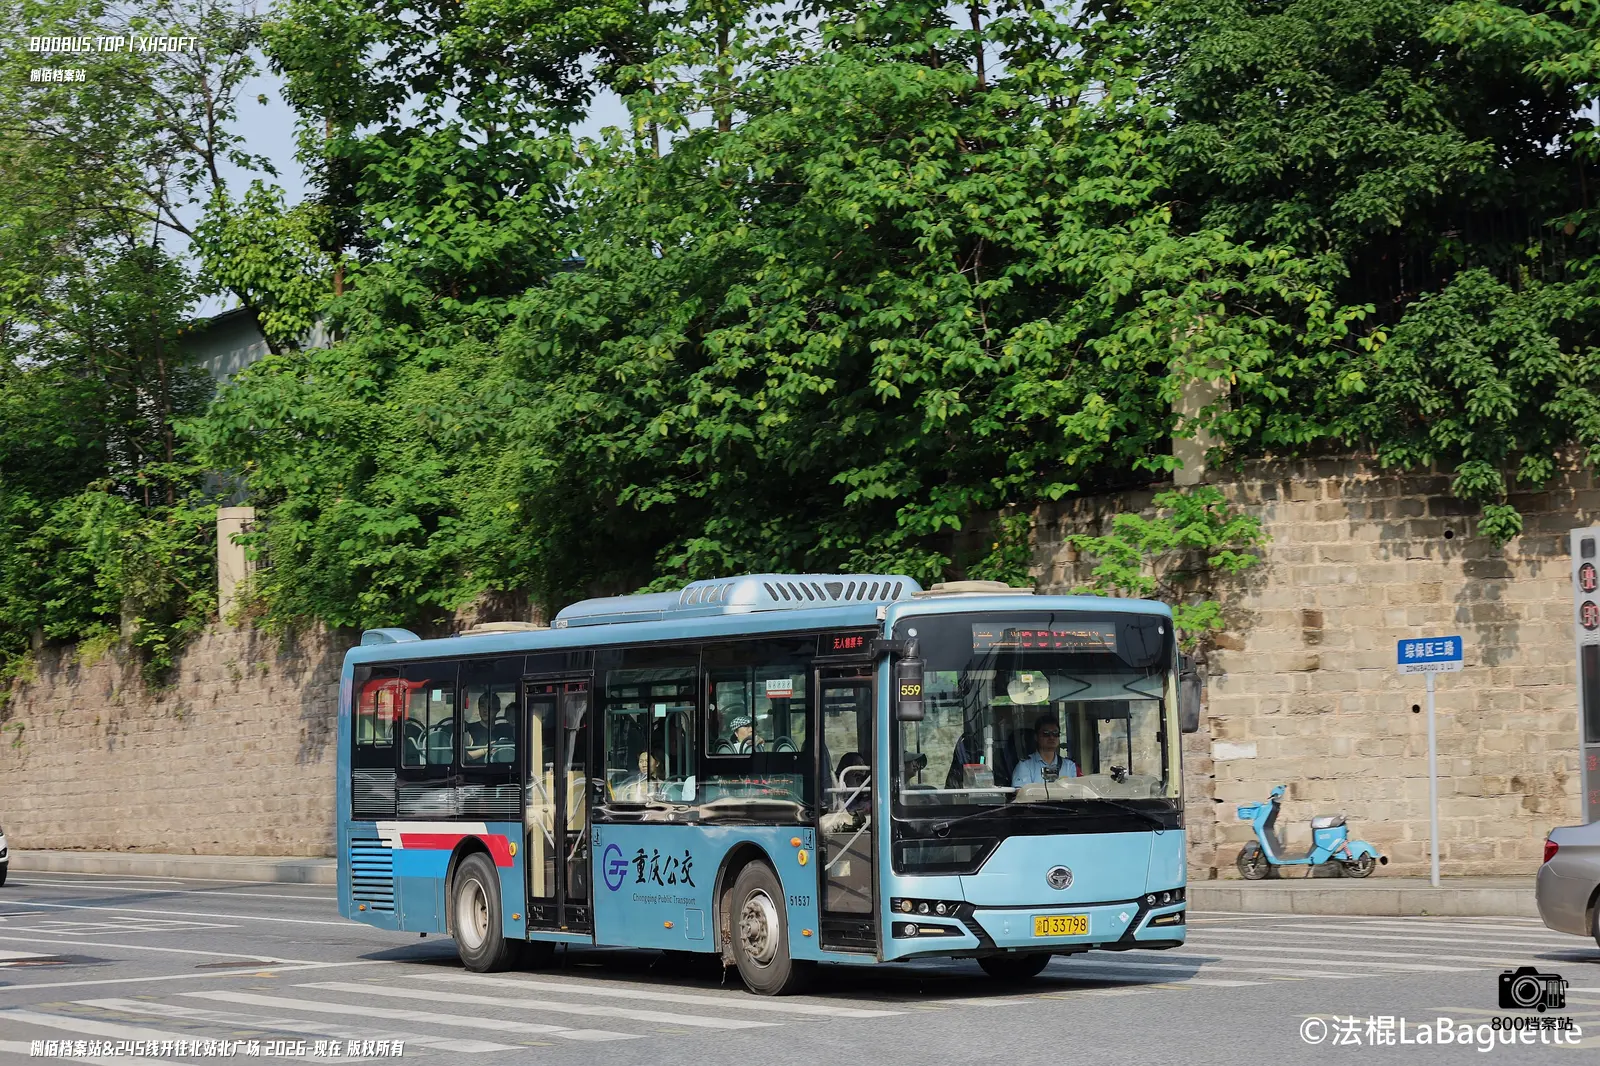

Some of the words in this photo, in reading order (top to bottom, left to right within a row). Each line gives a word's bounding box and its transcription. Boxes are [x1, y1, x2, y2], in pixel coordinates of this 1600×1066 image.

[900, 684, 921, 696] 559
[632, 848, 696, 888] 重庆公交
[632, 892, 658, 905] Chongqing
[658, 894, 673, 904] Public
[673, 895, 697, 906] Transport
[789, 895, 811, 907] 51537
